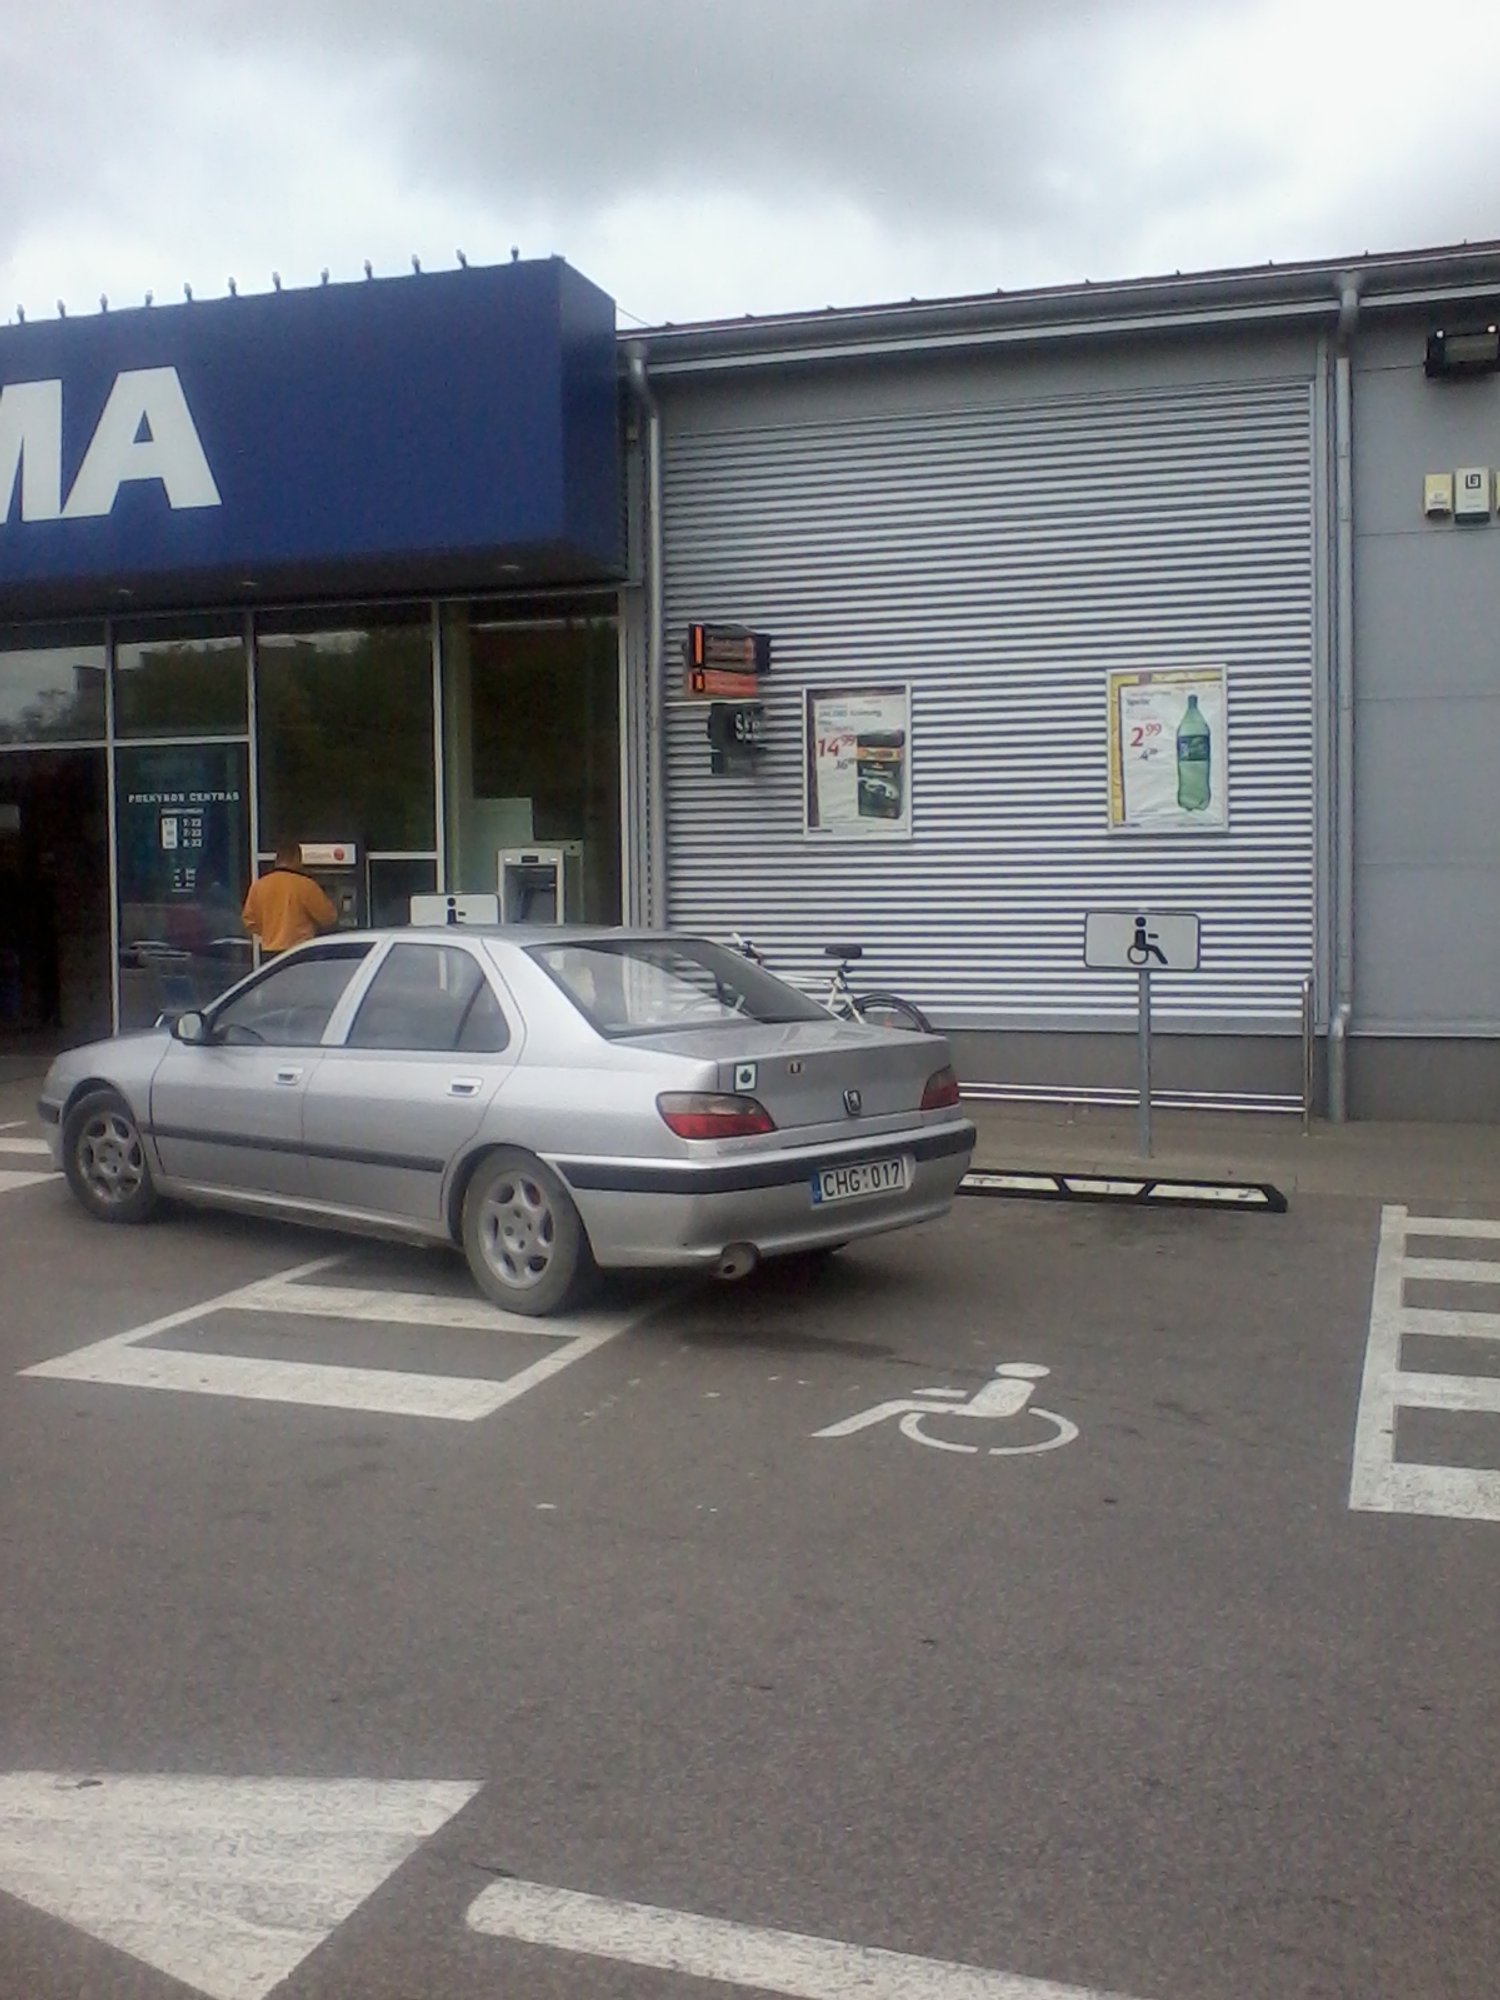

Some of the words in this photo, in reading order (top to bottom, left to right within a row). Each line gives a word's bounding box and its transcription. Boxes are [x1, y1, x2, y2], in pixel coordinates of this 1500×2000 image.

[189, 791, 240, 802] CENTRAS
[822, 1168, 861, 1197] CHG
[870, 1161, 900, 1189] 017
